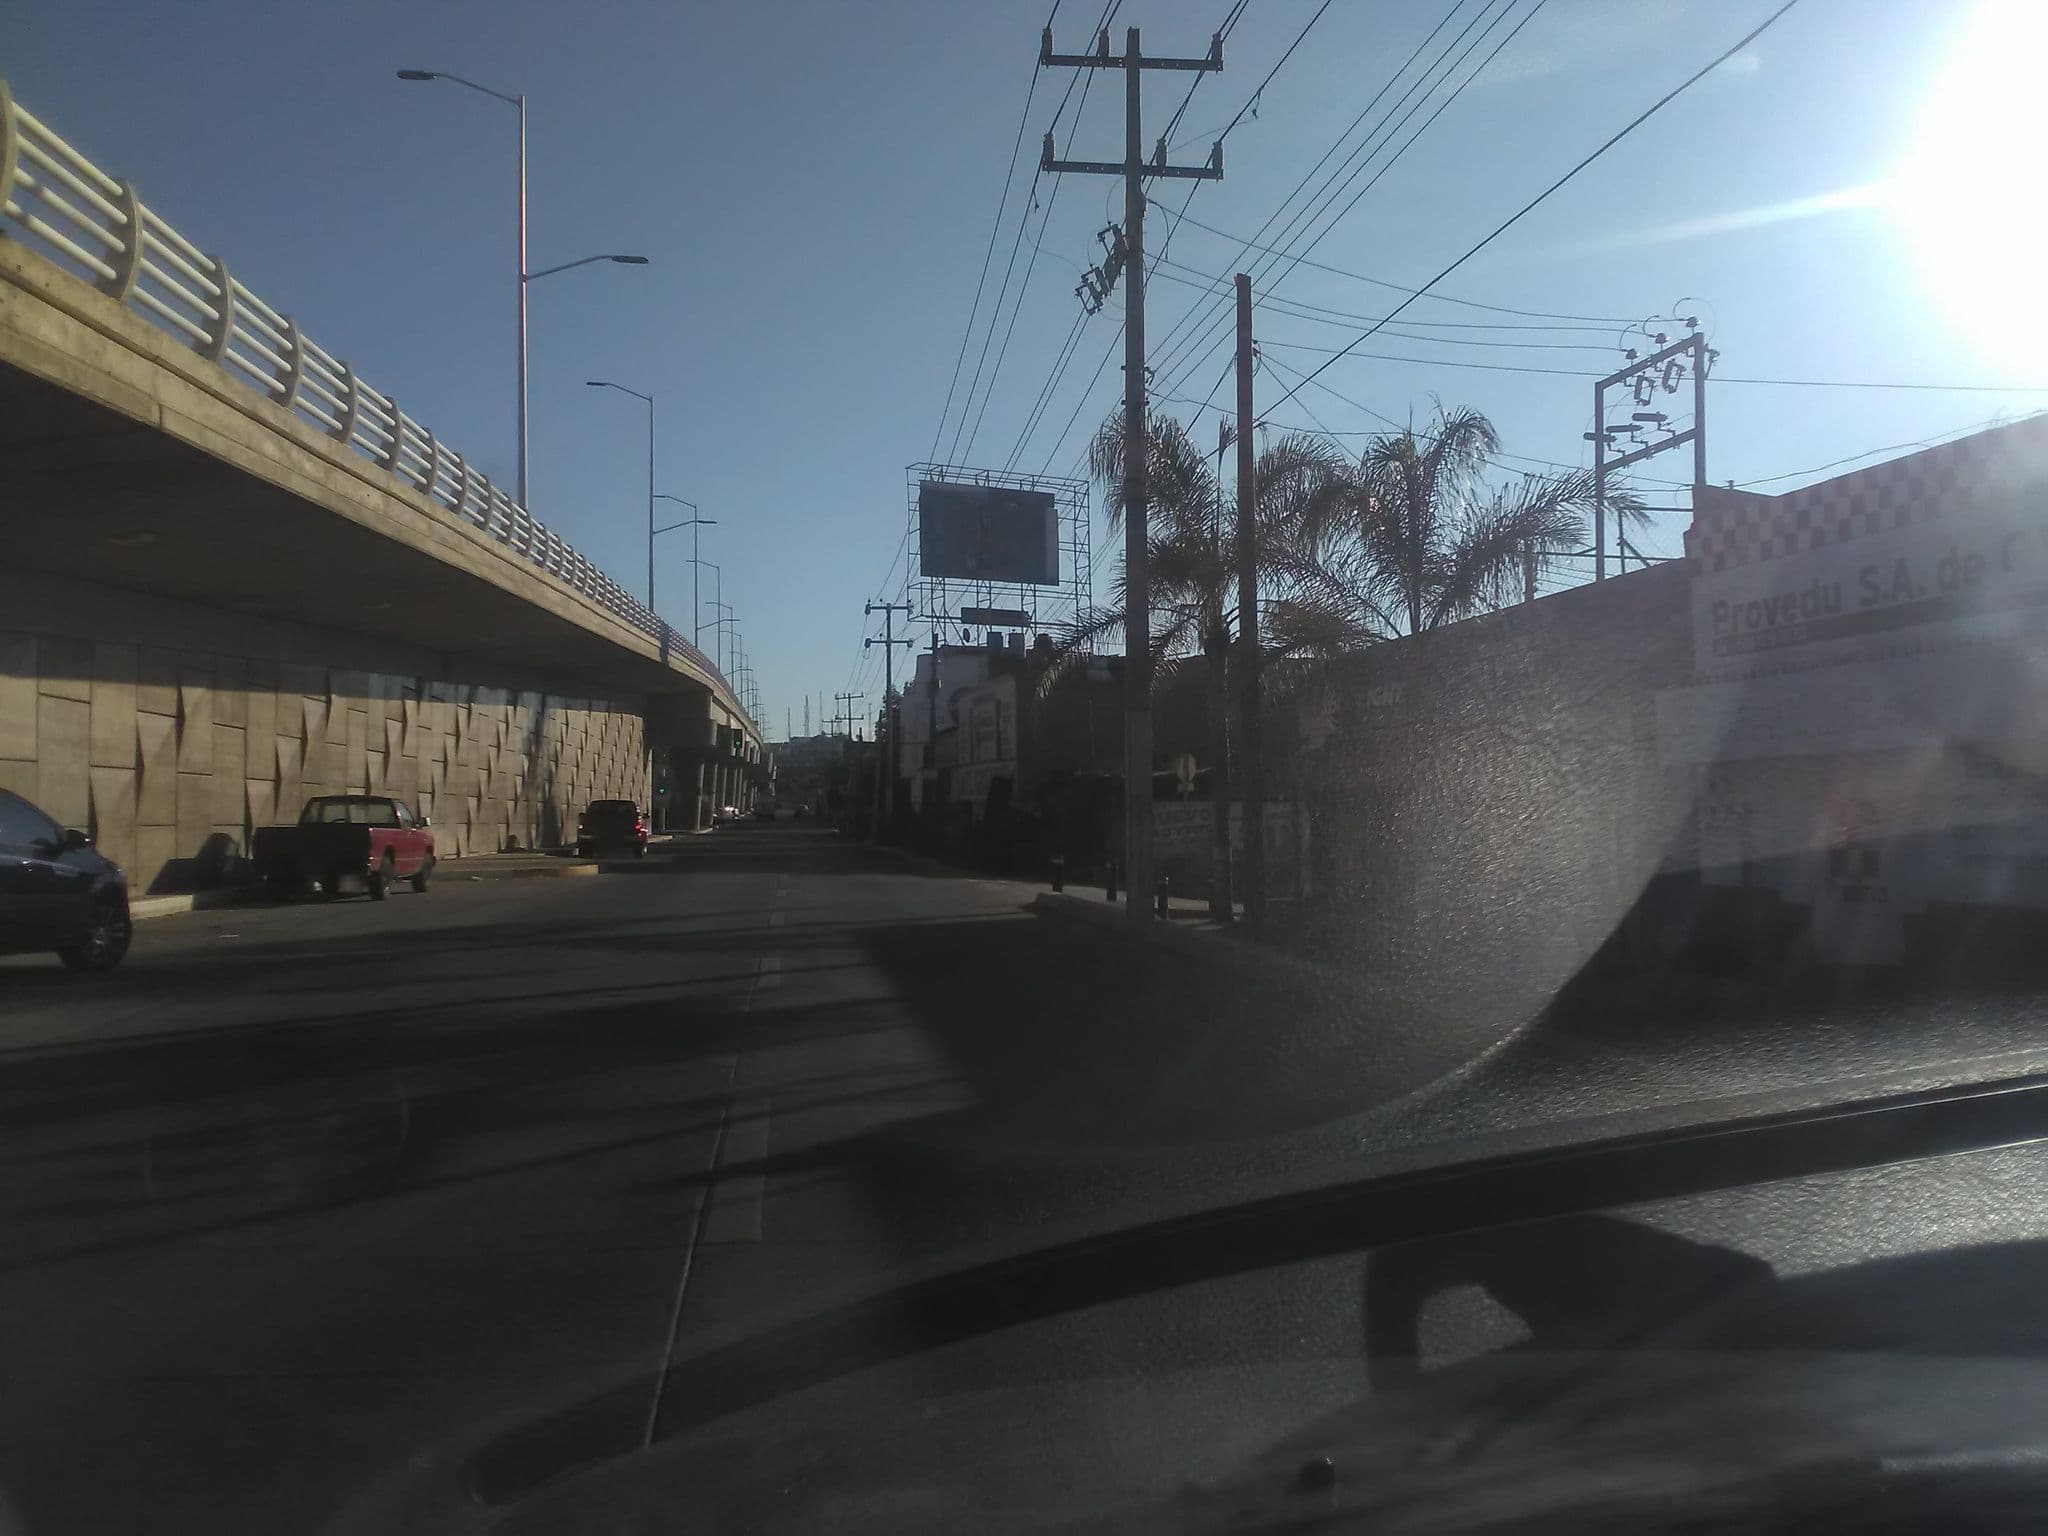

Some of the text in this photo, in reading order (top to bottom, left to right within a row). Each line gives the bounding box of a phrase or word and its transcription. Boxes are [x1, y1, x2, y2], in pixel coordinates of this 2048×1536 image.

[1712, 578, 1842, 634] Provedu
[1859, 557, 1928, 607] S.A.
[1937, 545, 1986, 593] de
